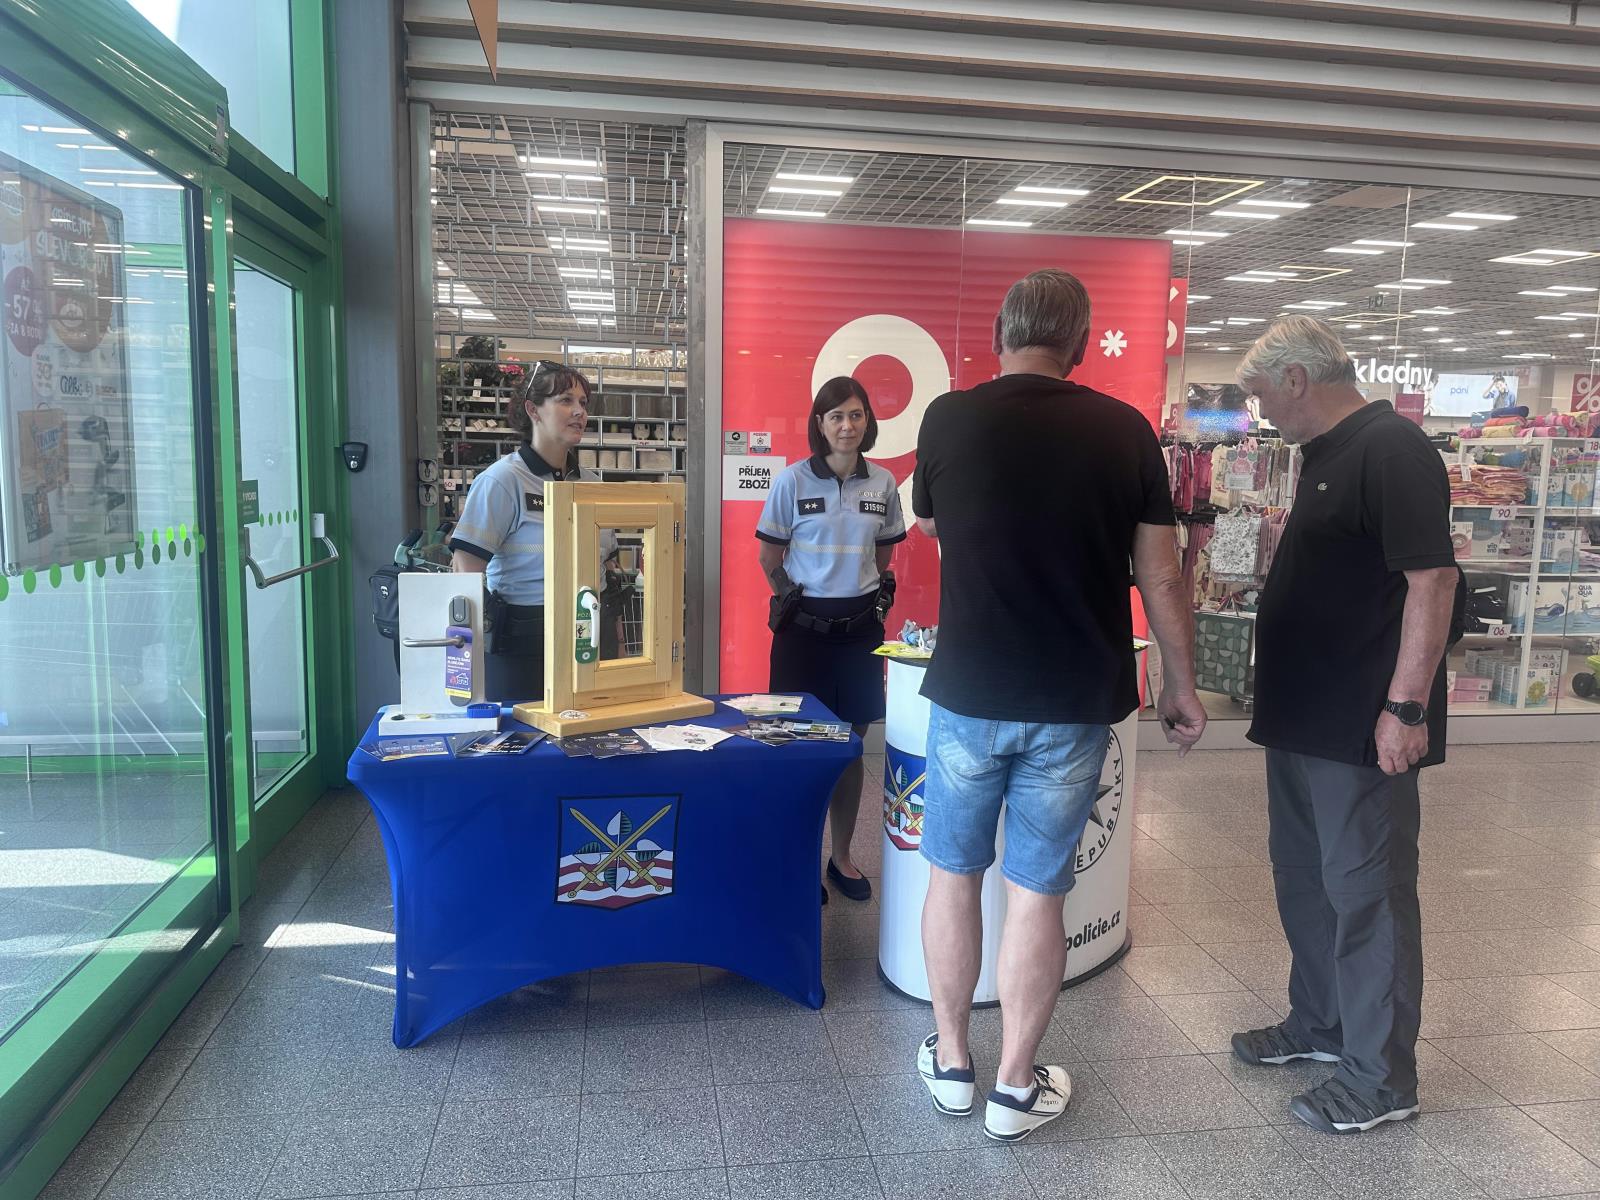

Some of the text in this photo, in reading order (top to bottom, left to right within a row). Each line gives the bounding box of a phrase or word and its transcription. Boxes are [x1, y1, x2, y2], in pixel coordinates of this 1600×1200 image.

[1354, 357, 1433, 387] kladny
[738, 465, 771, 477] PŘÍJEM
[738, 477, 771, 489] ZBOŽÍ
[1075, 757, 1121, 869] EPUBLIKY
[1066, 909, 1121, 951] policie.cz
